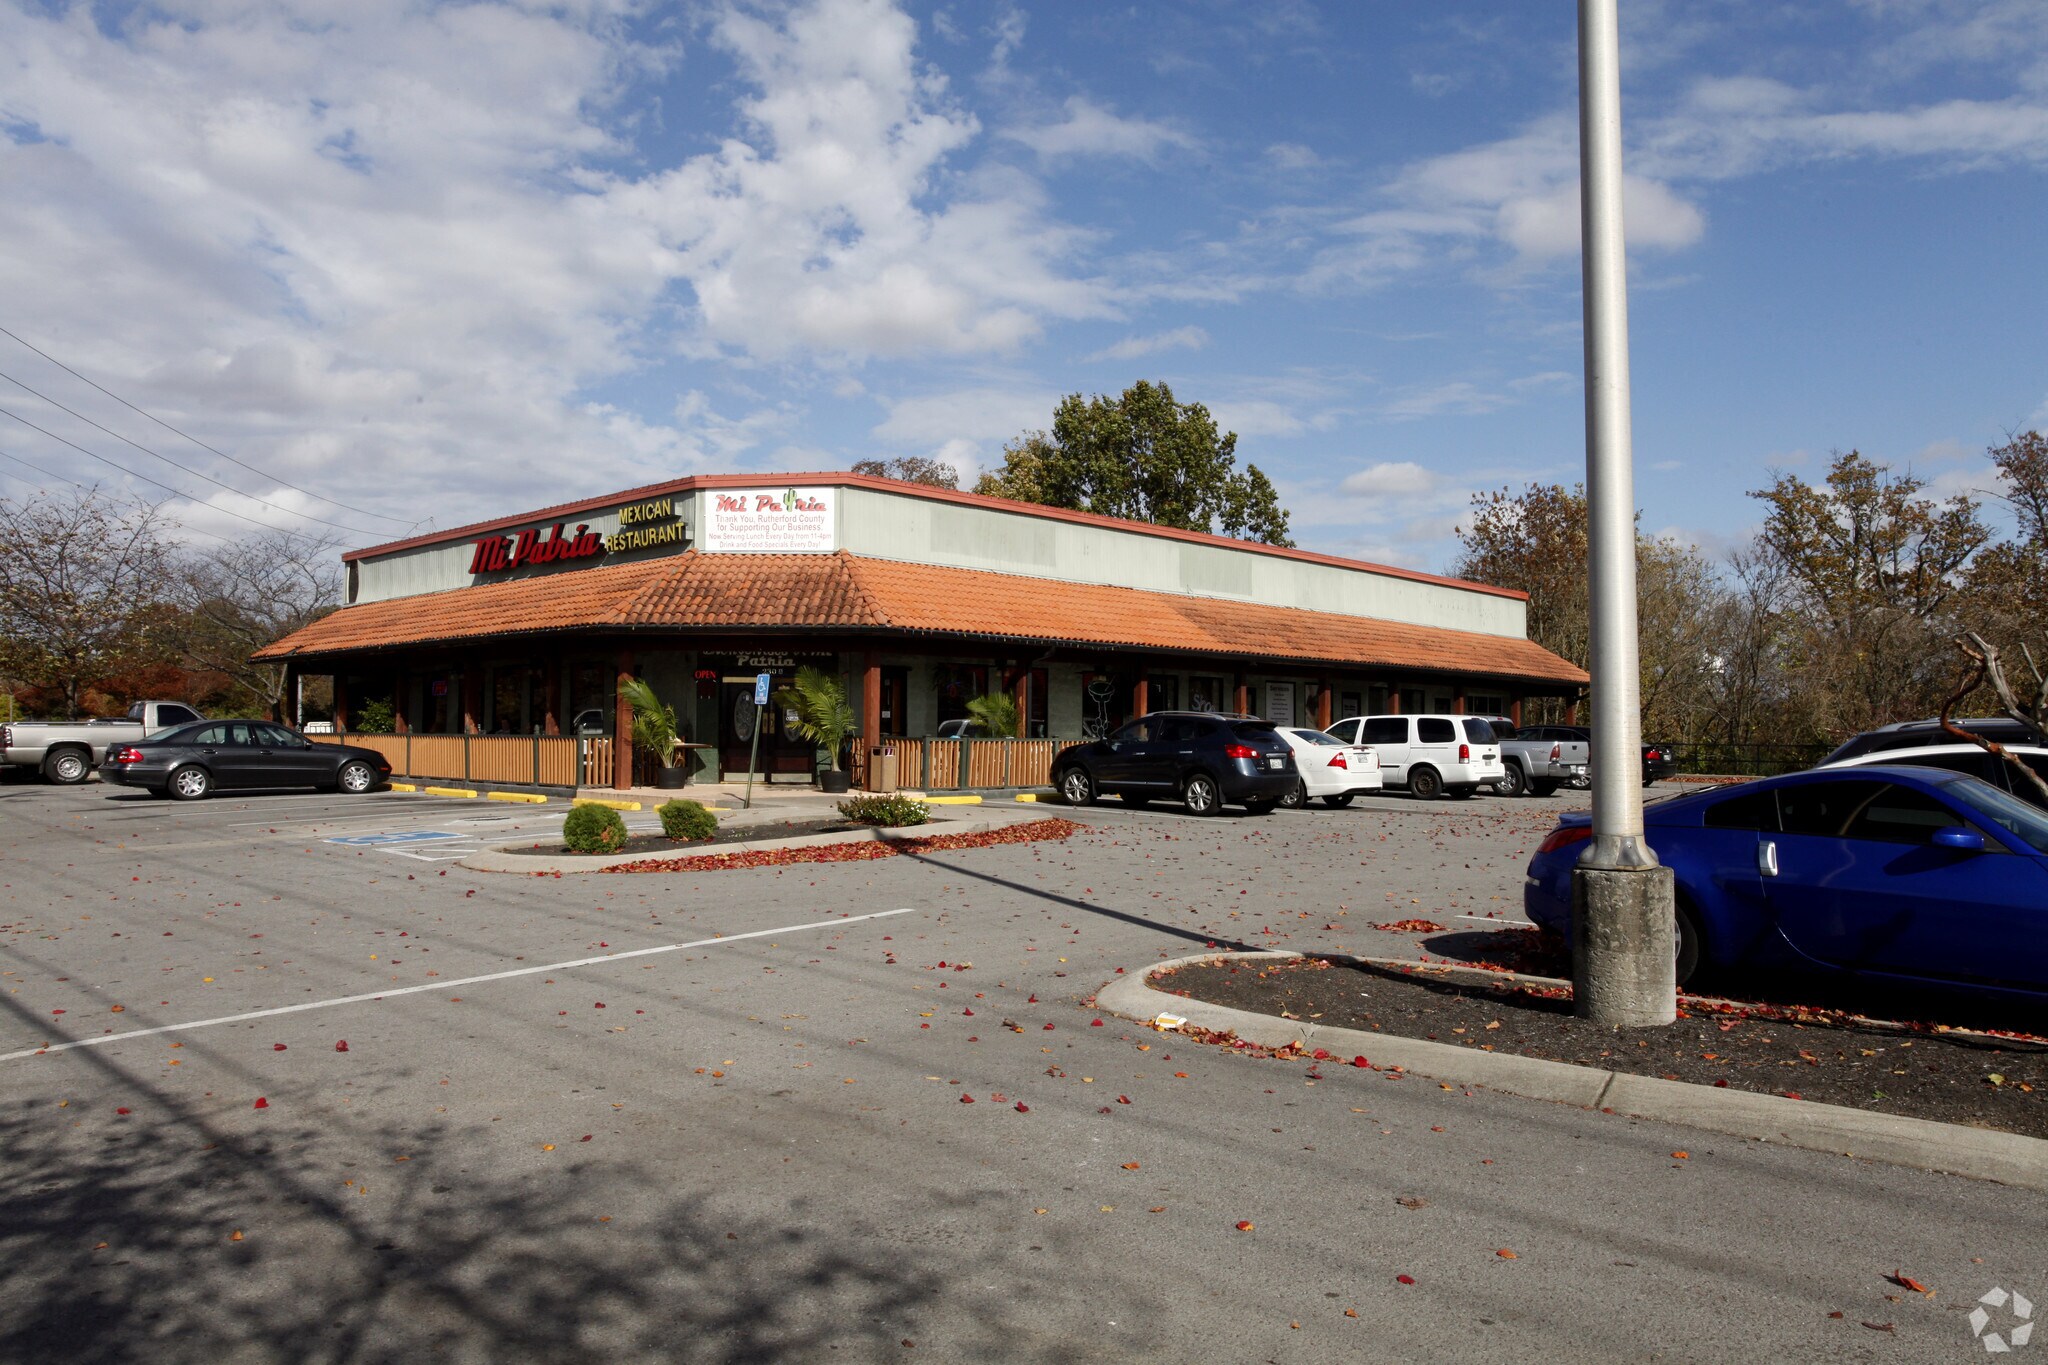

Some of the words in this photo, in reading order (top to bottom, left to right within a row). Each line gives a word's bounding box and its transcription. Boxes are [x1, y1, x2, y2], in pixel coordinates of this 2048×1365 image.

[715, 494, 747, 512] Mi
[618, 499, 671, 525] MEXICAN
[716, 515, 738, 523] Thank
[740, 515, 756, 524] You,
[758, 515, 797, 523] Rutherford
[799, 515, 825, 524] County
[717, 523, 727, 531] for
[729, 523, 770, 533] Supporting
[772, 523, 785, 531] Our
[787, 523, 823, 531] Business.
[605, 522, 685, 552] RESTAURANT
[723, 533, 744, 541] Serving
[766, 533, 782, 541] Every
[784, 533, 794, 541] Day
[468, 534, 511, 574] Mi
[511, 523, 602, 568] Patria
[764, 541, 789, 549] Specials
[790, 541, 806, 549] Every
[737, 655, 795, 666] Patria
[694, 670, 716, 679] OPEN
